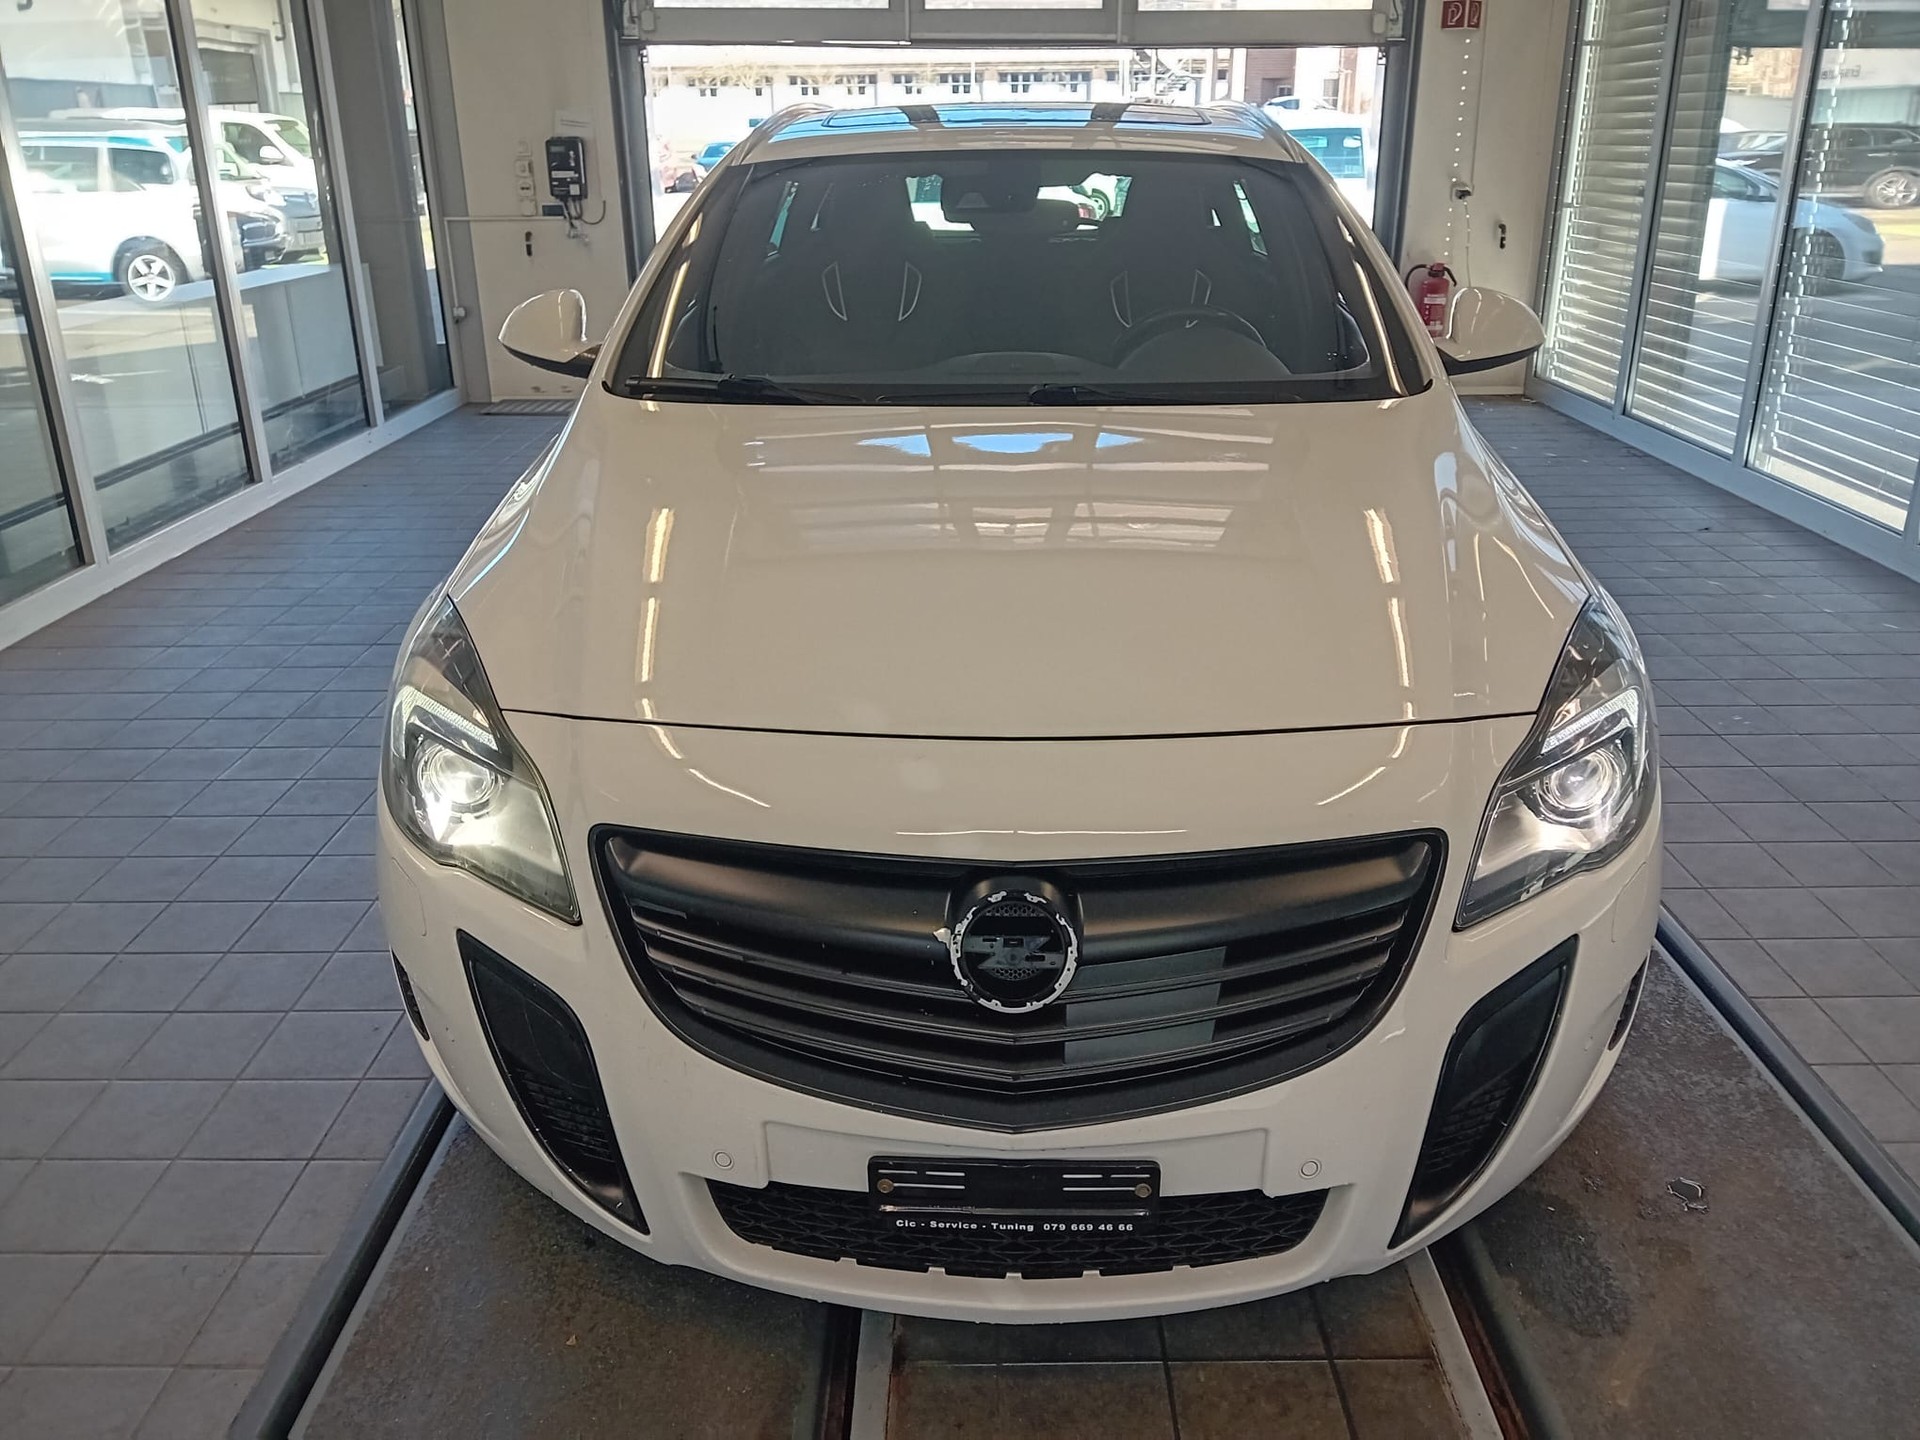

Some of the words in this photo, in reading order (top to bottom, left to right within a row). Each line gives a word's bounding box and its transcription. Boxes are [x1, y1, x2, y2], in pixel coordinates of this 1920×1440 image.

[929, 1220, 978, 1230] Service
[990, 1222, 1034, 1232] Tuning
[1043, 1223, 1066, 1231] 079
[1070, 1223, 1094, 1231] 669
[1098, 1223, 1114, 1231] 46
[1118, 1223, 1134, 1231] 66
